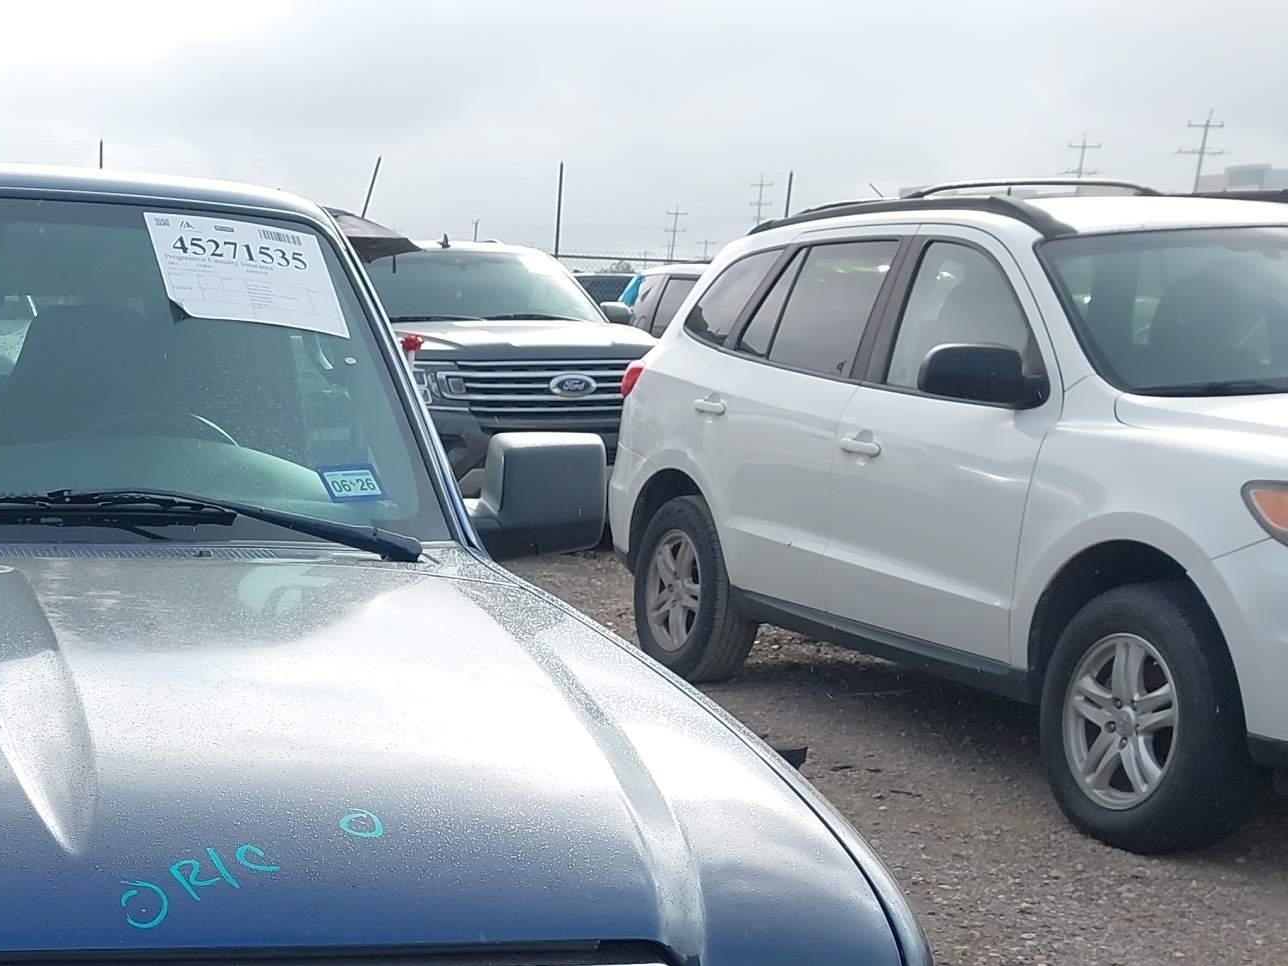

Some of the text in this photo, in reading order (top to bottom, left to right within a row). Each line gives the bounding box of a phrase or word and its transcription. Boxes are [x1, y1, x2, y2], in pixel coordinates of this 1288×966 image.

[172, 235, 308, 271] 45271535
[561, 379, 586, 391] Ford
[331, 478, 376, 493] 06 26
